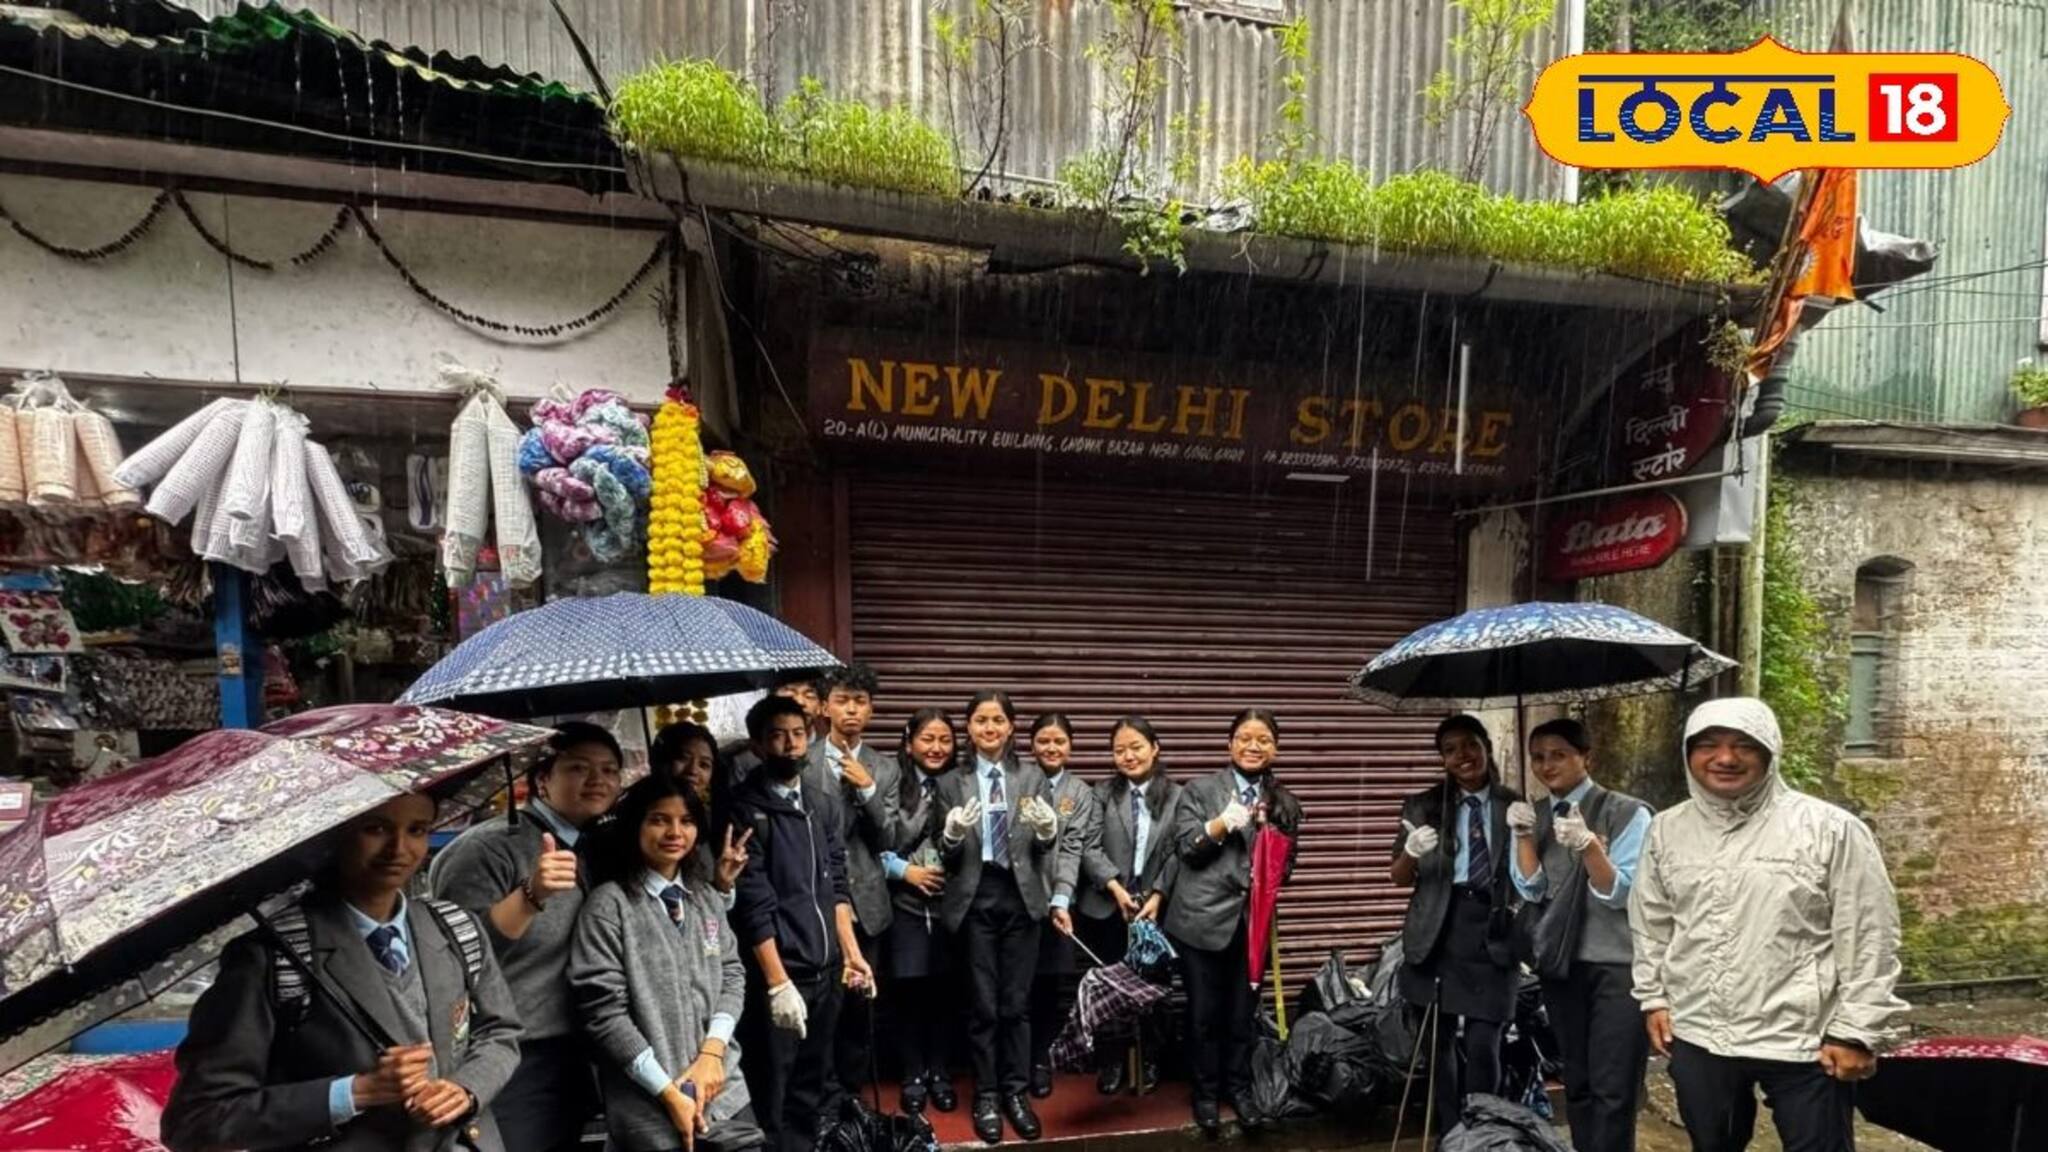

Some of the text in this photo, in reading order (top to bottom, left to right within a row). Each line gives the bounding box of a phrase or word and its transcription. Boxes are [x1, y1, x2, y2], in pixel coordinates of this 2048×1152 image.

[846, 357, 1513, 458] NEW DELHI STORE
[1624, 404, 1690, 446] दिल्ली
[892, 424, 988, 446] MUNICIPALITY
[1106, 439, 1145, 456] BAZAR
[1631, 441, 1688, 481] स्टोर
[1559, 511, 1667, 555] Bata
